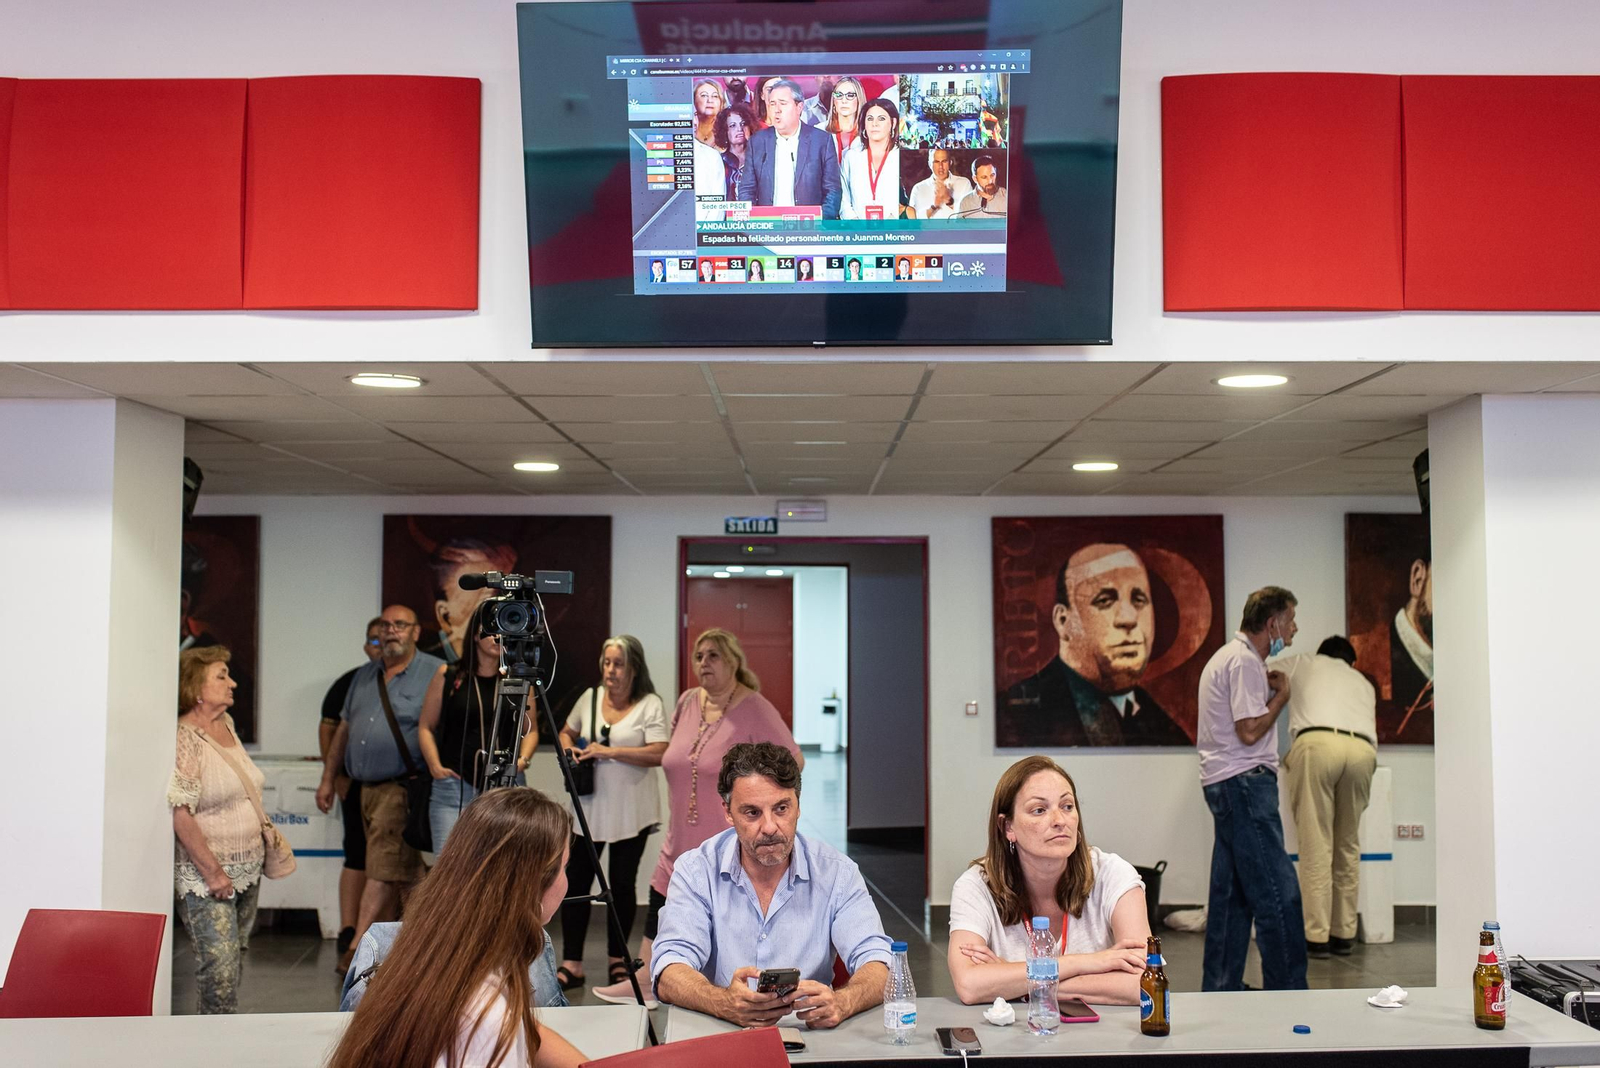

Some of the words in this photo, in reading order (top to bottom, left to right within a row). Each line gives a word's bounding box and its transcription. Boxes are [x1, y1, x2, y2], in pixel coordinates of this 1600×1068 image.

[702, 221, 745, 230] ANDALUCÍA
[702, 235, 736, 244] Espadas
[748, 234, 784, 242] felicitado
[785, 234, 844, 243] personalmente
[852, 233, 884, 241] Juanma
[885, 233, 915, 241] Moreno
[681, 259, 694, 269] 57
[730, 259, 742, 269] 31
[780, 259, 792, 268] 14
[832, 258, 839, 267] 5
[881, 258, 888, 267] 2
[930, 258, 938, 267] 0
[728, 519, 775, 533] SALIDA
